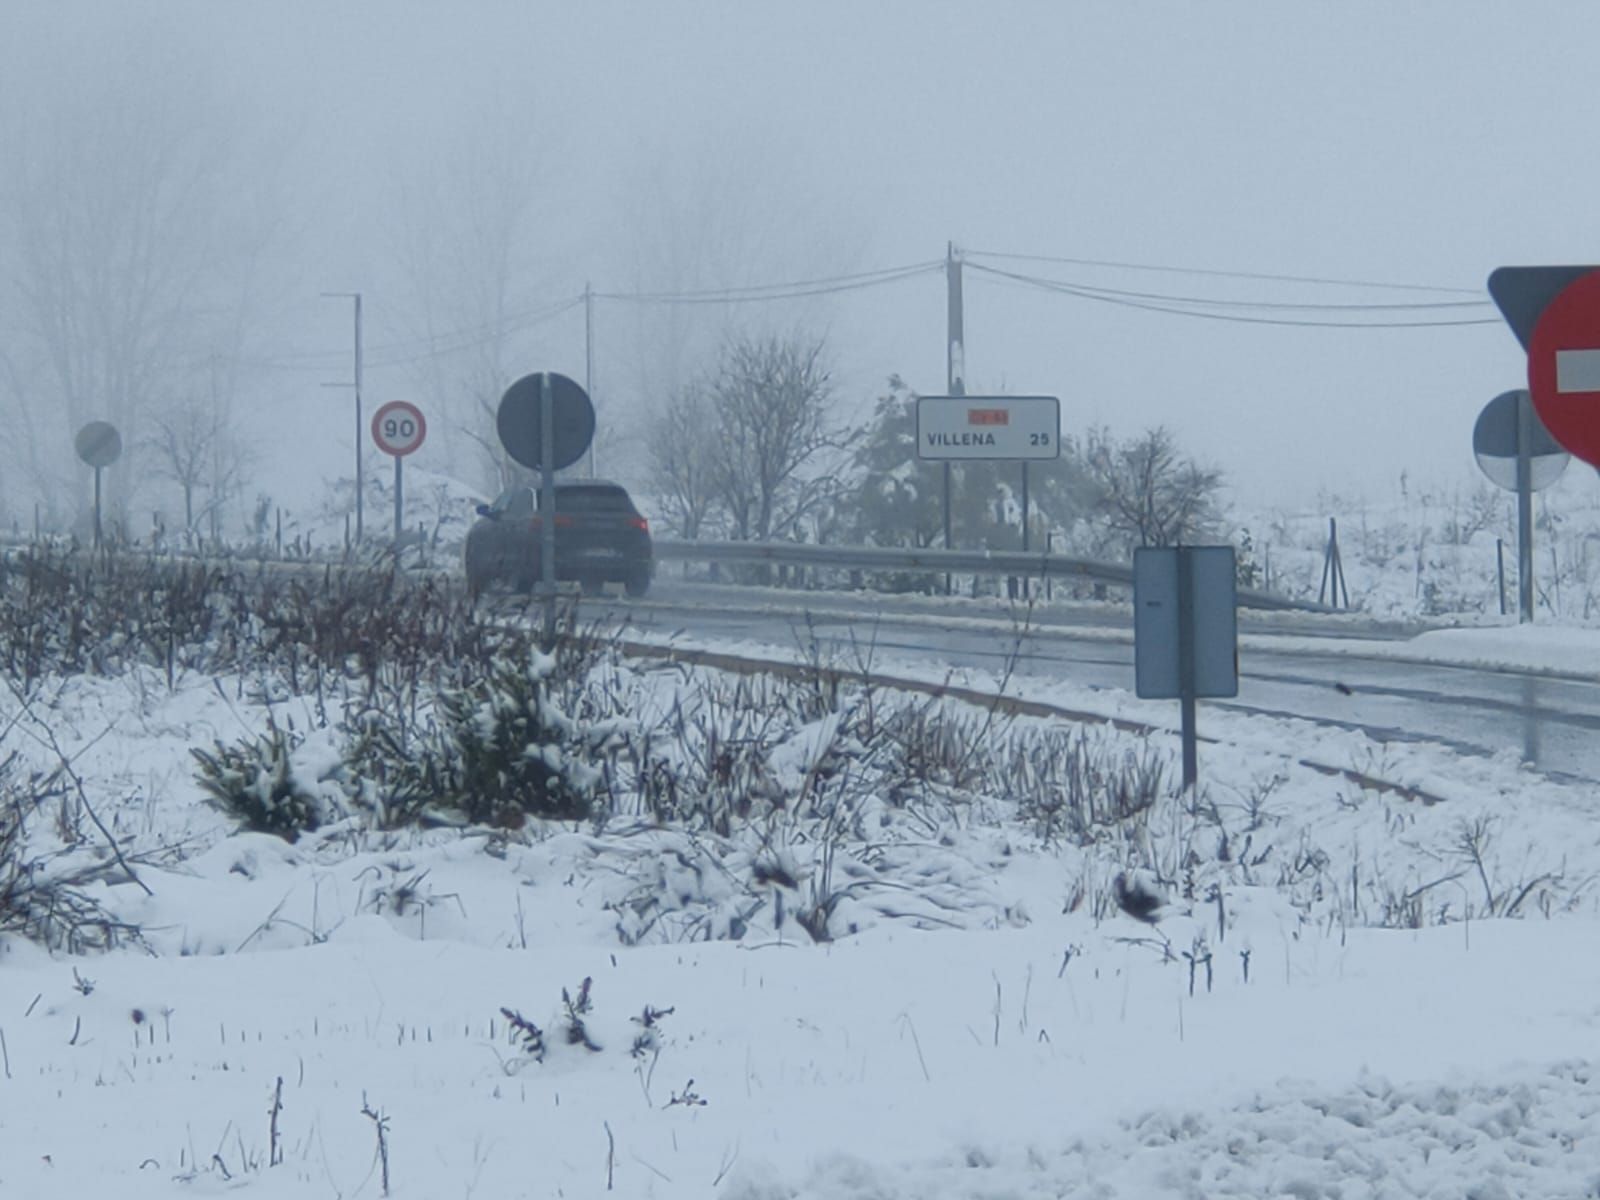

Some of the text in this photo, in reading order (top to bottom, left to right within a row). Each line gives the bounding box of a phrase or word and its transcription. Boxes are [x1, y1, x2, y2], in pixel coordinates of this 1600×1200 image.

[385, 419, 414, 438] 90
[927, 432, 1050, 446] VILLENA 25
